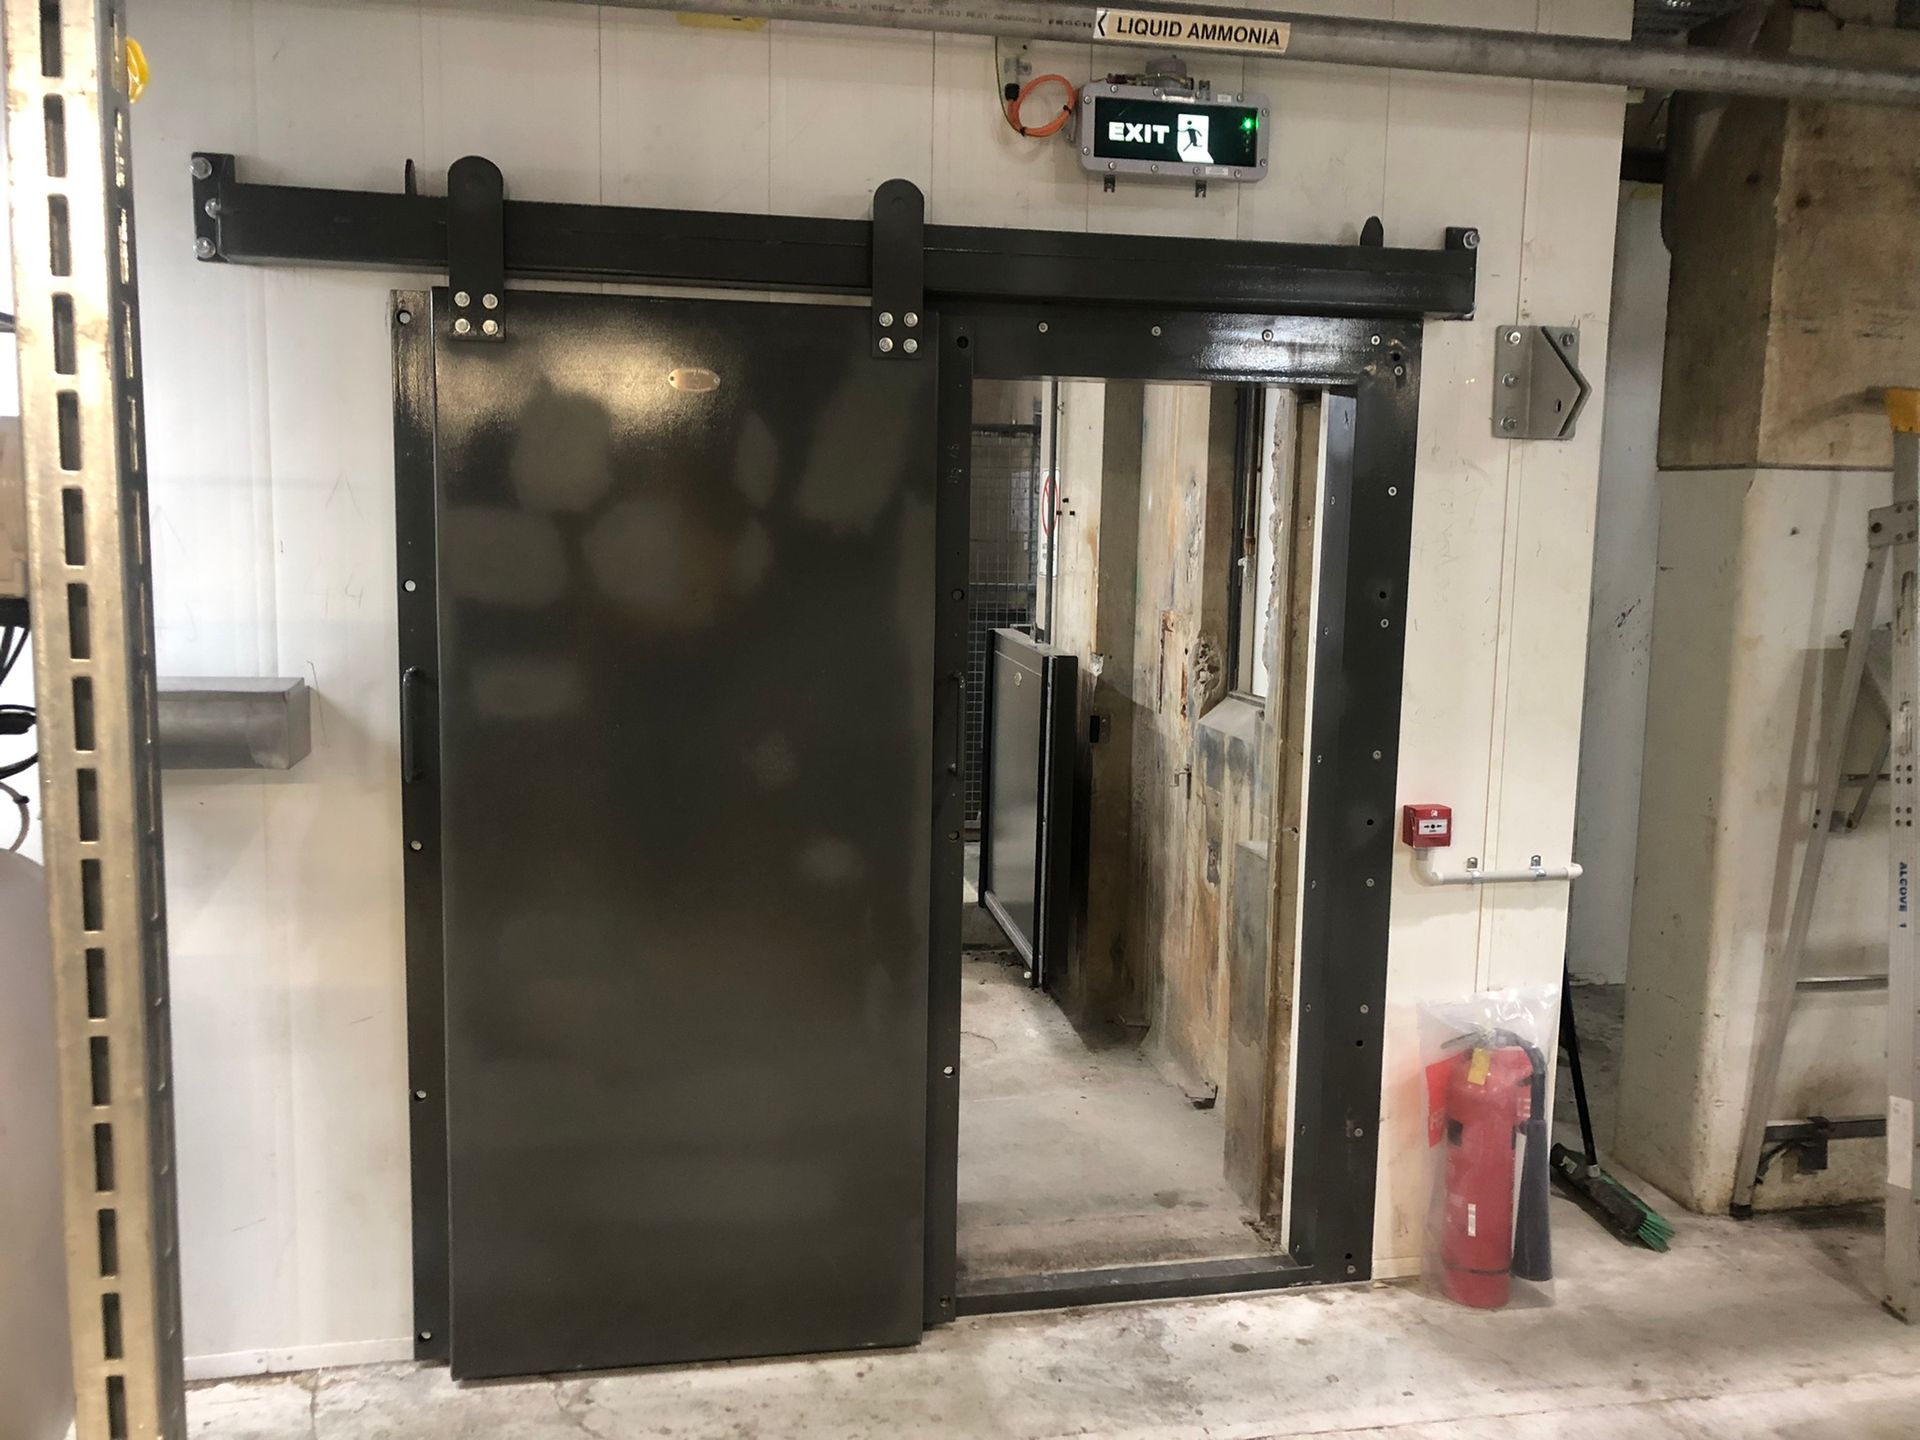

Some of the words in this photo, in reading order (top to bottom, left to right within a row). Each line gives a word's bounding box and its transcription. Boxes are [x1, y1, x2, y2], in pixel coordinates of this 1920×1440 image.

[1117, 17, 1182, 38] LIQUID
[1187, 22, 1280, 46] AMMONIA
[1108, 121, 1170, 144] EXIT
[1899, 862, 1908, 912] ALCOVE
